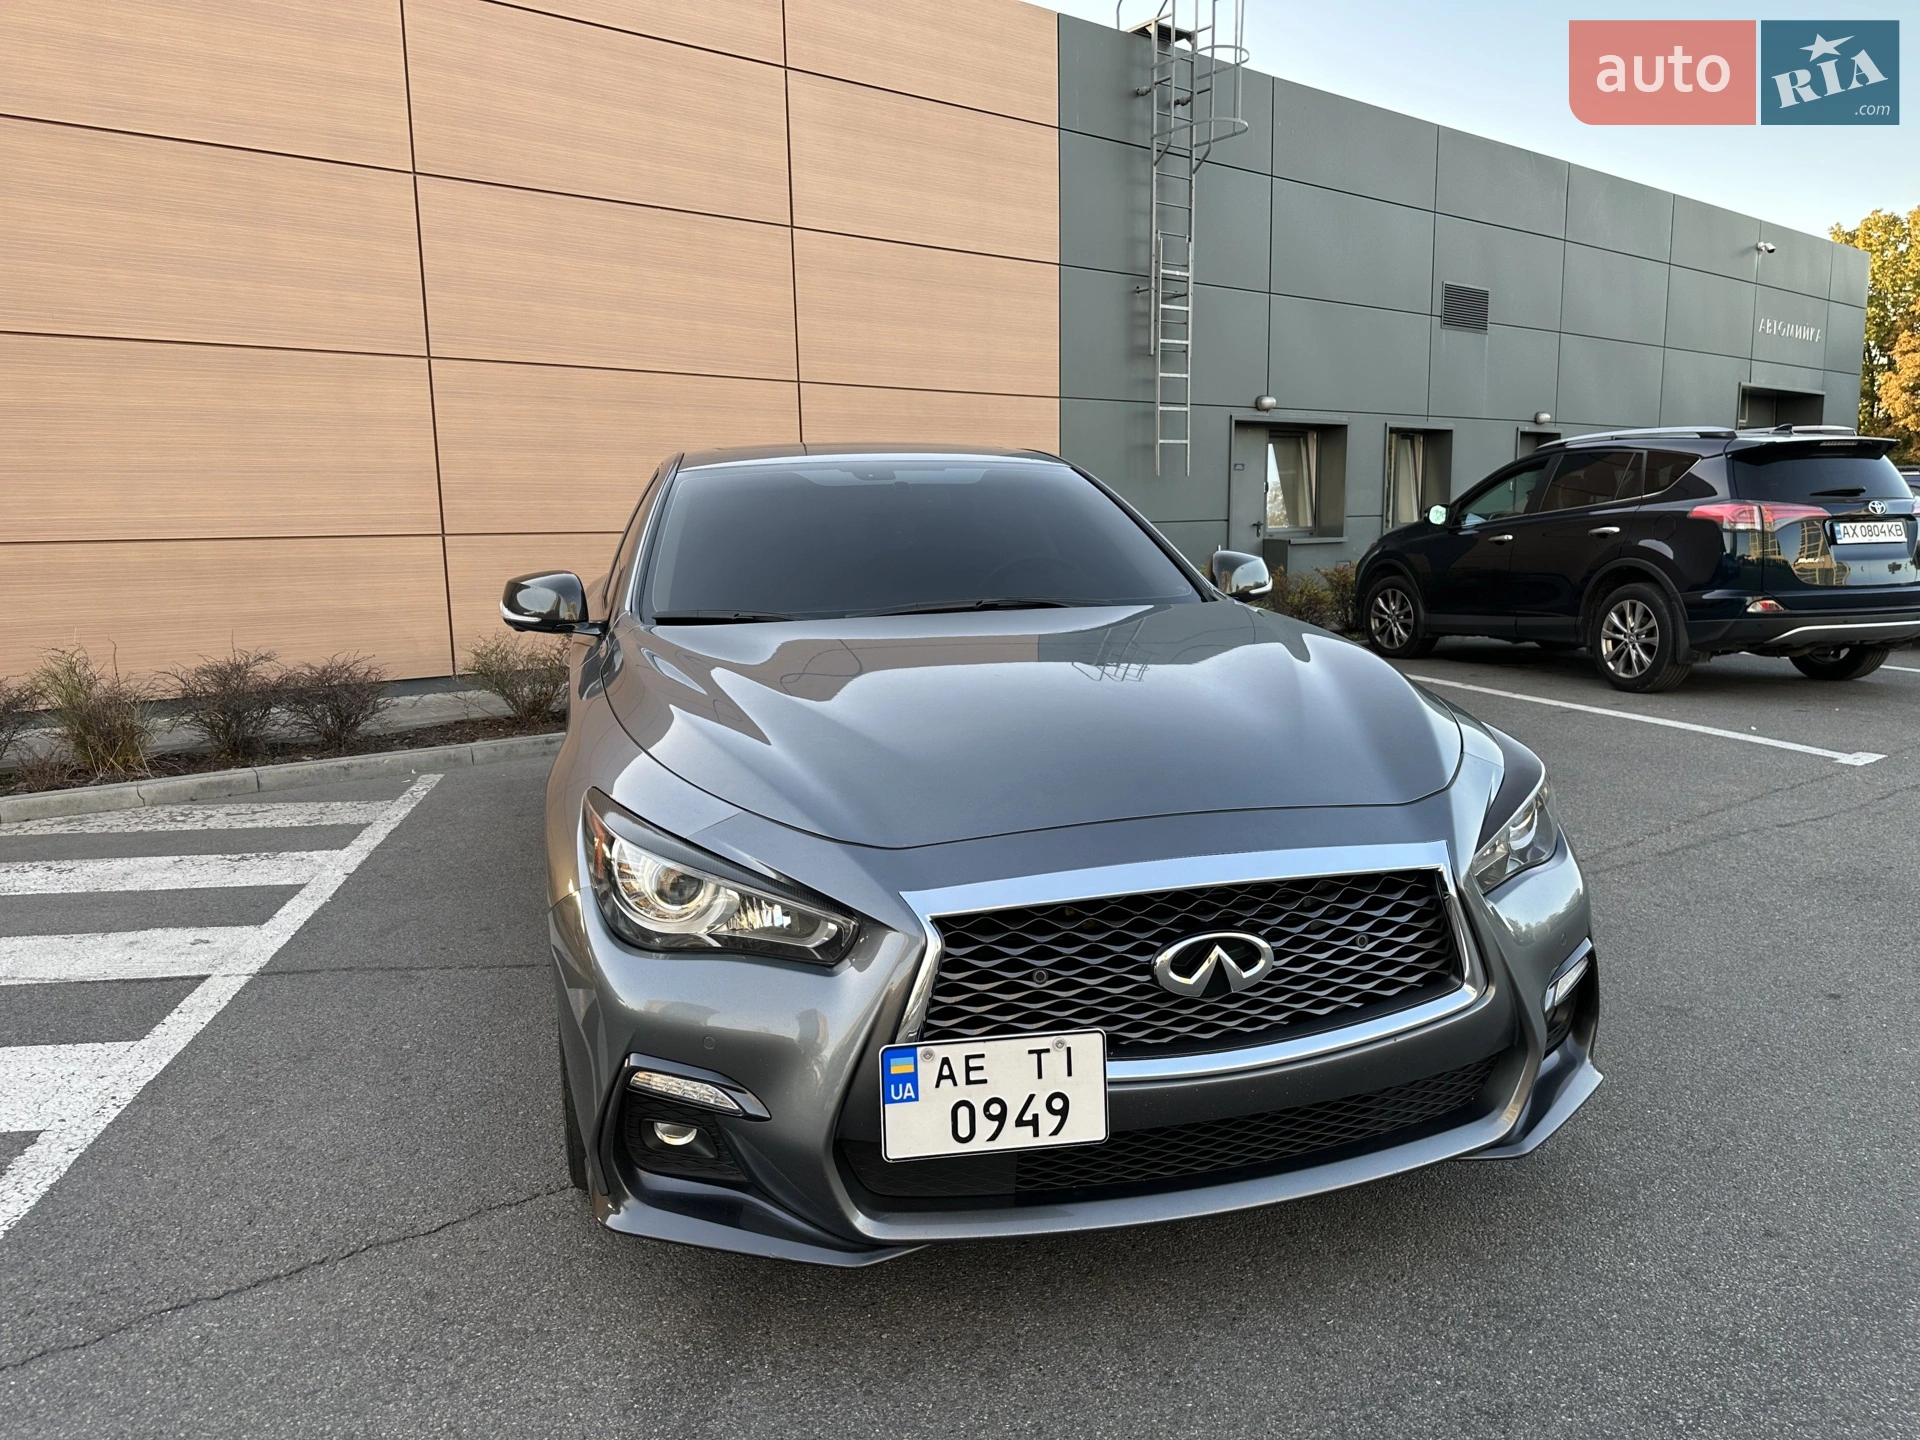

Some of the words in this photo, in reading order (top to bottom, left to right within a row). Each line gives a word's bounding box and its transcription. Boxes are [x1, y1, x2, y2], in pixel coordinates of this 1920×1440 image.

[1758, 317, 1822, 342] АВТОМИЙКА
[935, 1053, 988, 1089] AE
[890, 1082, 916, 1100] UA
[951, 1091, 1070, 1144] 0949
